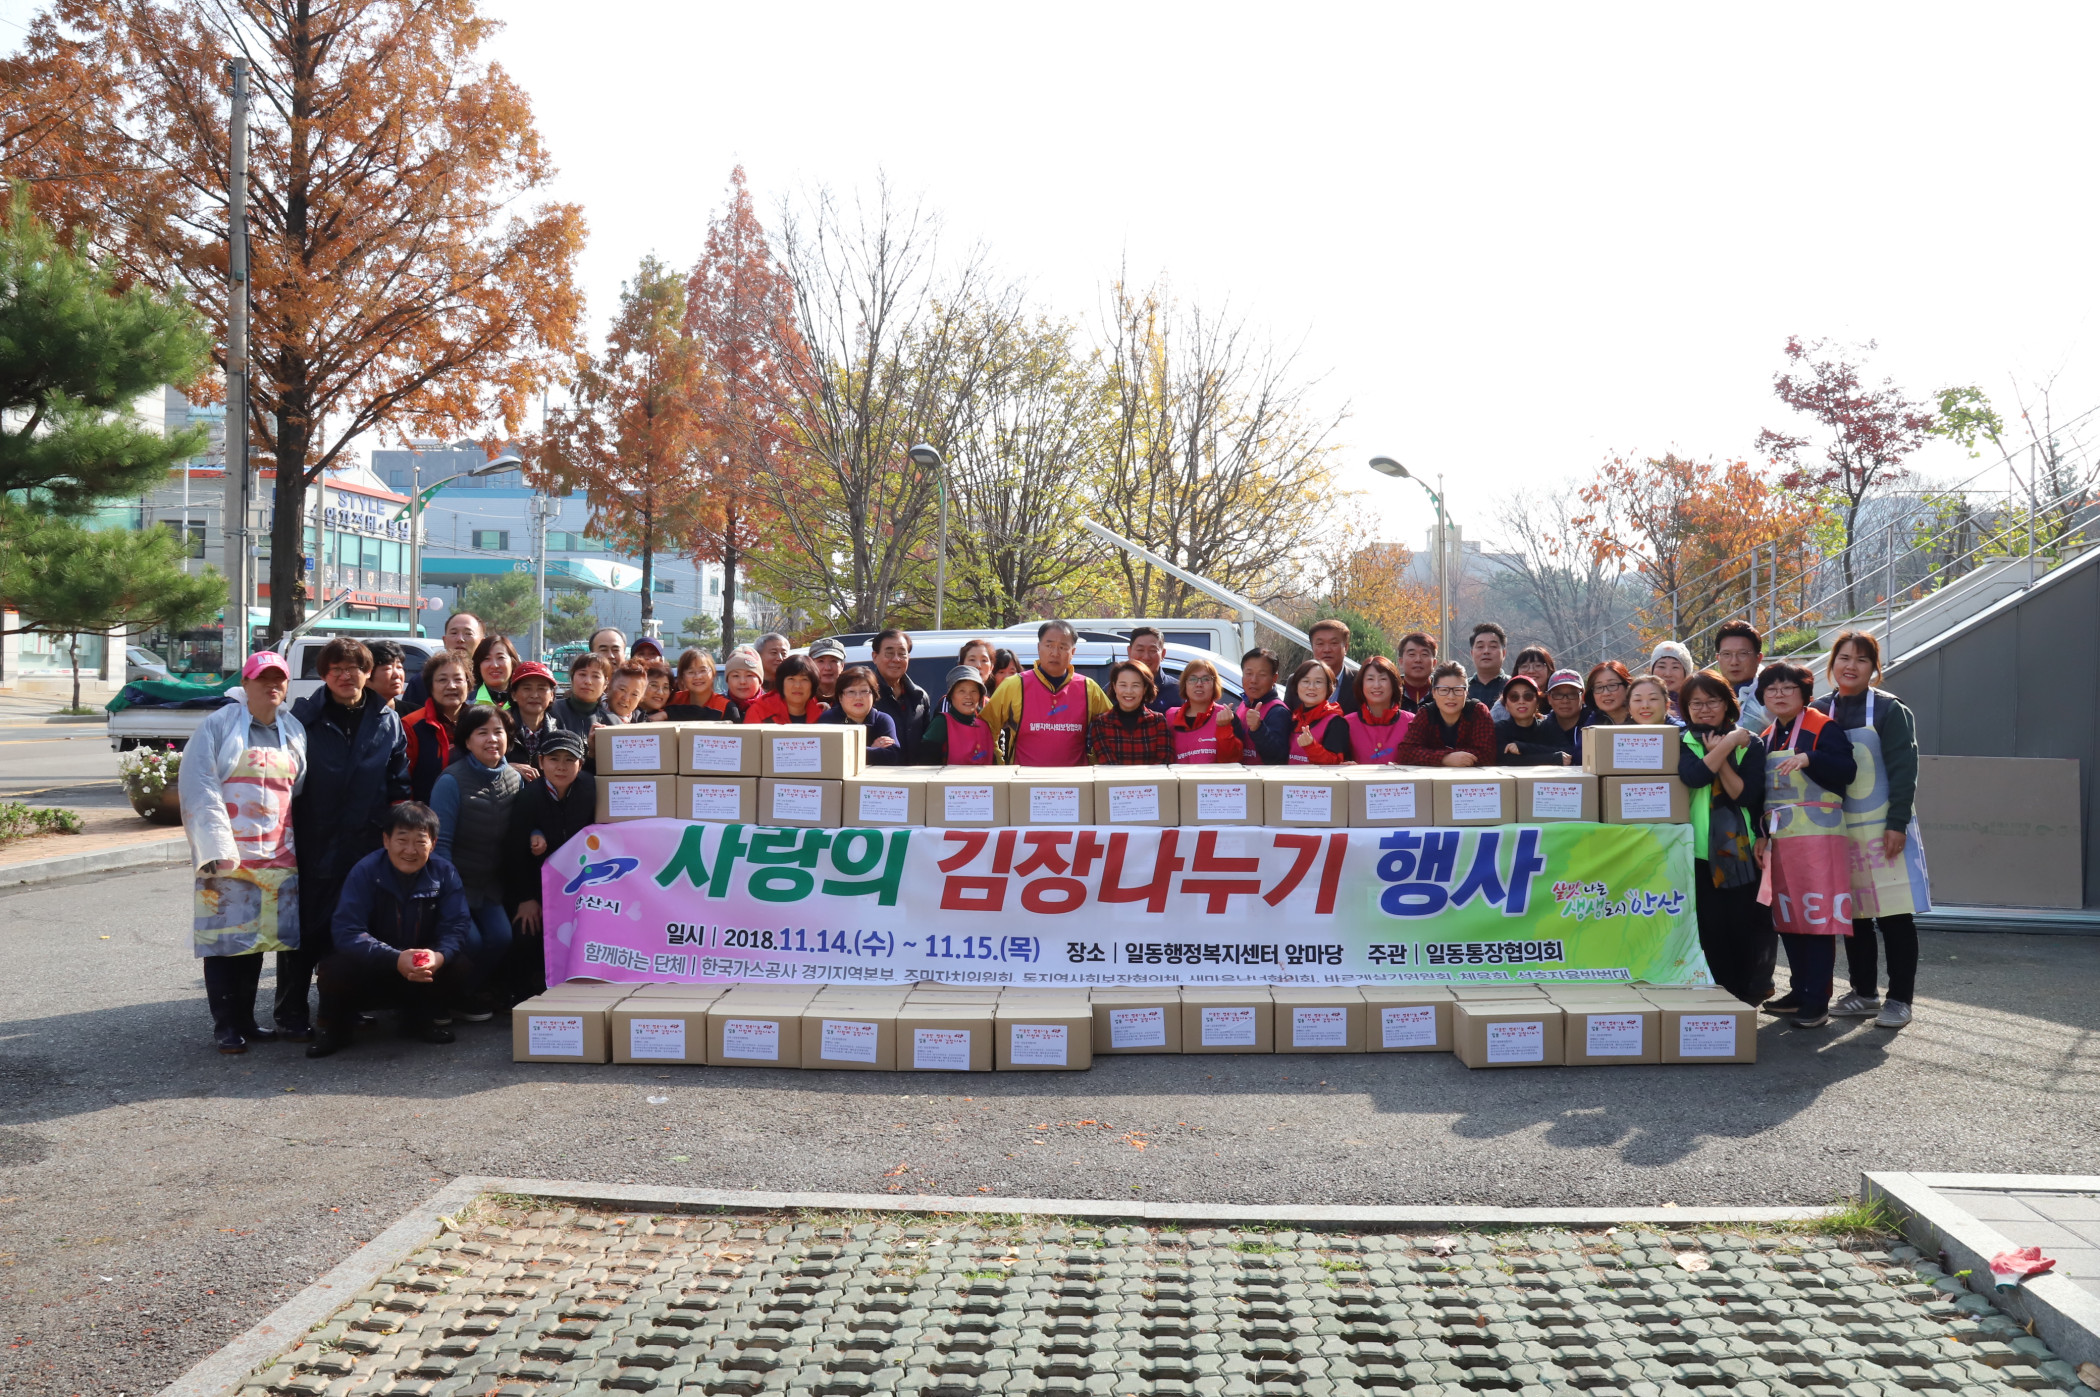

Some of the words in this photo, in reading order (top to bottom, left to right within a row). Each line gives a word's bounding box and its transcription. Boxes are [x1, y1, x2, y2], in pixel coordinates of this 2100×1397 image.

[338, 490, 385, 515] STYLE
[655, 824, 912, 906] 사랑의
[937, 829, 1348, 914] 김장나누기
[1376, 829, 1543, 914] 행사
[1631, 891, 1685, 914] 안산
[585, 942, 649, 972] 함께하는
[654, 954, 686, 975] 단체
[702, 956, 798, 980] 한국가스공사
[666, 923, 704, 946] 일시
[723, 927, 895, 957] 2018.11.14.(수)
[925, 935, 1041, 963] 11.15.(목)
[1066, 942, 1106, 964] 장소
[1125, 942, 1279, 965] 일동행정복지센터
[1285, 944, 1344, 965] 앞마당
[1368, 944, 1407, 965] 주관
[1426, 941, 1564, 964] 일동통장협의회
